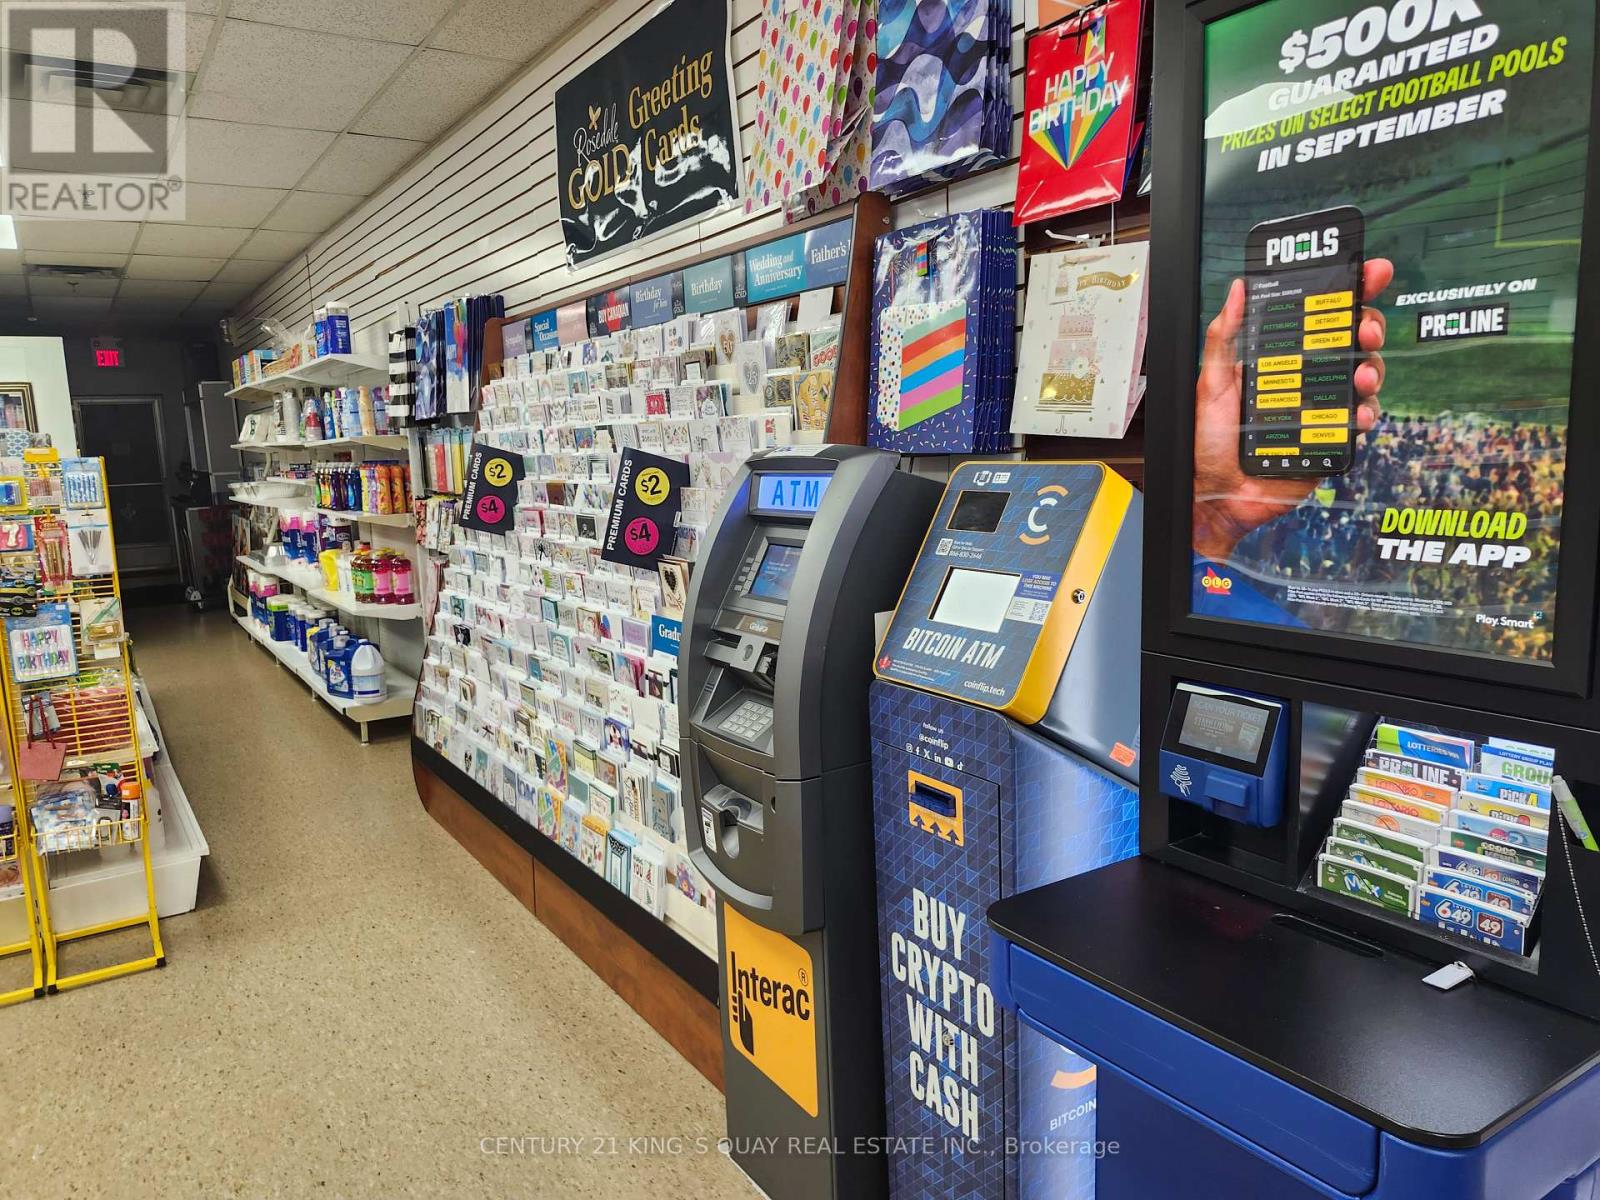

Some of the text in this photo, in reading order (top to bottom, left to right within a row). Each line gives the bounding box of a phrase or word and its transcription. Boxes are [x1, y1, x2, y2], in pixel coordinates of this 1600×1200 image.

[1278, 0, 1482, 73] $500K
[1044, 51, 1115, 106] HAPPY
[1267, 23, 1501, 112] GUARANTEED
[628, 51, 714, 131] Greeting
[1029, 75, 1131, 133] BIRTHDAY
[1220, 35, 1569, 154] PRIZES ON SELECT FOOTBALL POOLS
[573, 101, 620, 167] Rosedale
[644, 104, 702, 172] Cards
[1256, 88, 1508, 173] IN SEPTEMBER
[567, 142, 634, 211] GOLD
[749, 253, 784, 272] Wedding
[783, 249, 794, 264] and
[811, 239, 847, 265] Father's
[1266, 227, 1340, 266] POOLS
[691, 275, 723, 297] Birthday
[753, 264, 803, 287] Anniversary
[635, 285, 662, 303] Birthday
[1315, 297, 1342, 306] BUFFALO
[1395, 277, 1538, 307] EXCLUSIVELY ON
[598, 302, 630, 324] BUY CANADIAN
[1315, 316, 1340, 325] DETROIT
[1420, 306, 1506, 339] PROLINE
[96, 350, 119, 367] EXIT
[1273, 359, 1298, 367] ANGELES
[1263, 378, 1295, 386] MINNESOTA
[462, 452, 482, 520] PREMIUM CARDS
[489, 463, 507, 479] $2
[640, 474, 662, 496] $2
[481, 499, 498, 513] $4
[606, 459, 633, 551] PREMIUM CARDS
[771, 479, 820, 508] ATM
[630, 522, 651, 542] $4
[1380, 507, 1528, 541] DOWNLOAD
[1377, 537, 1532, 569] THE APP
[1499, 615, 1535, 630] Smart
[22, 627, 60, 649] HAPPY
[903, 627, 967, 662] BITCOIN
[961, 638, 1006, 670] ATM
[17, 648, 70, 671] BIRTHDAY
[964, 680, 1006, 697] coinflip.tech
[919, 732, 949, 751] @coinflip
[922, 721, 937, 733] follow
[912, 887, 967, 962] BUY
[891, 932, 995, 1038] CRYPTO
[905, 993, 979, 1087] WITH
[909, 1051, 980, 1144] CASH
[1049, 1098, 1097, 1132] BITCOIN
